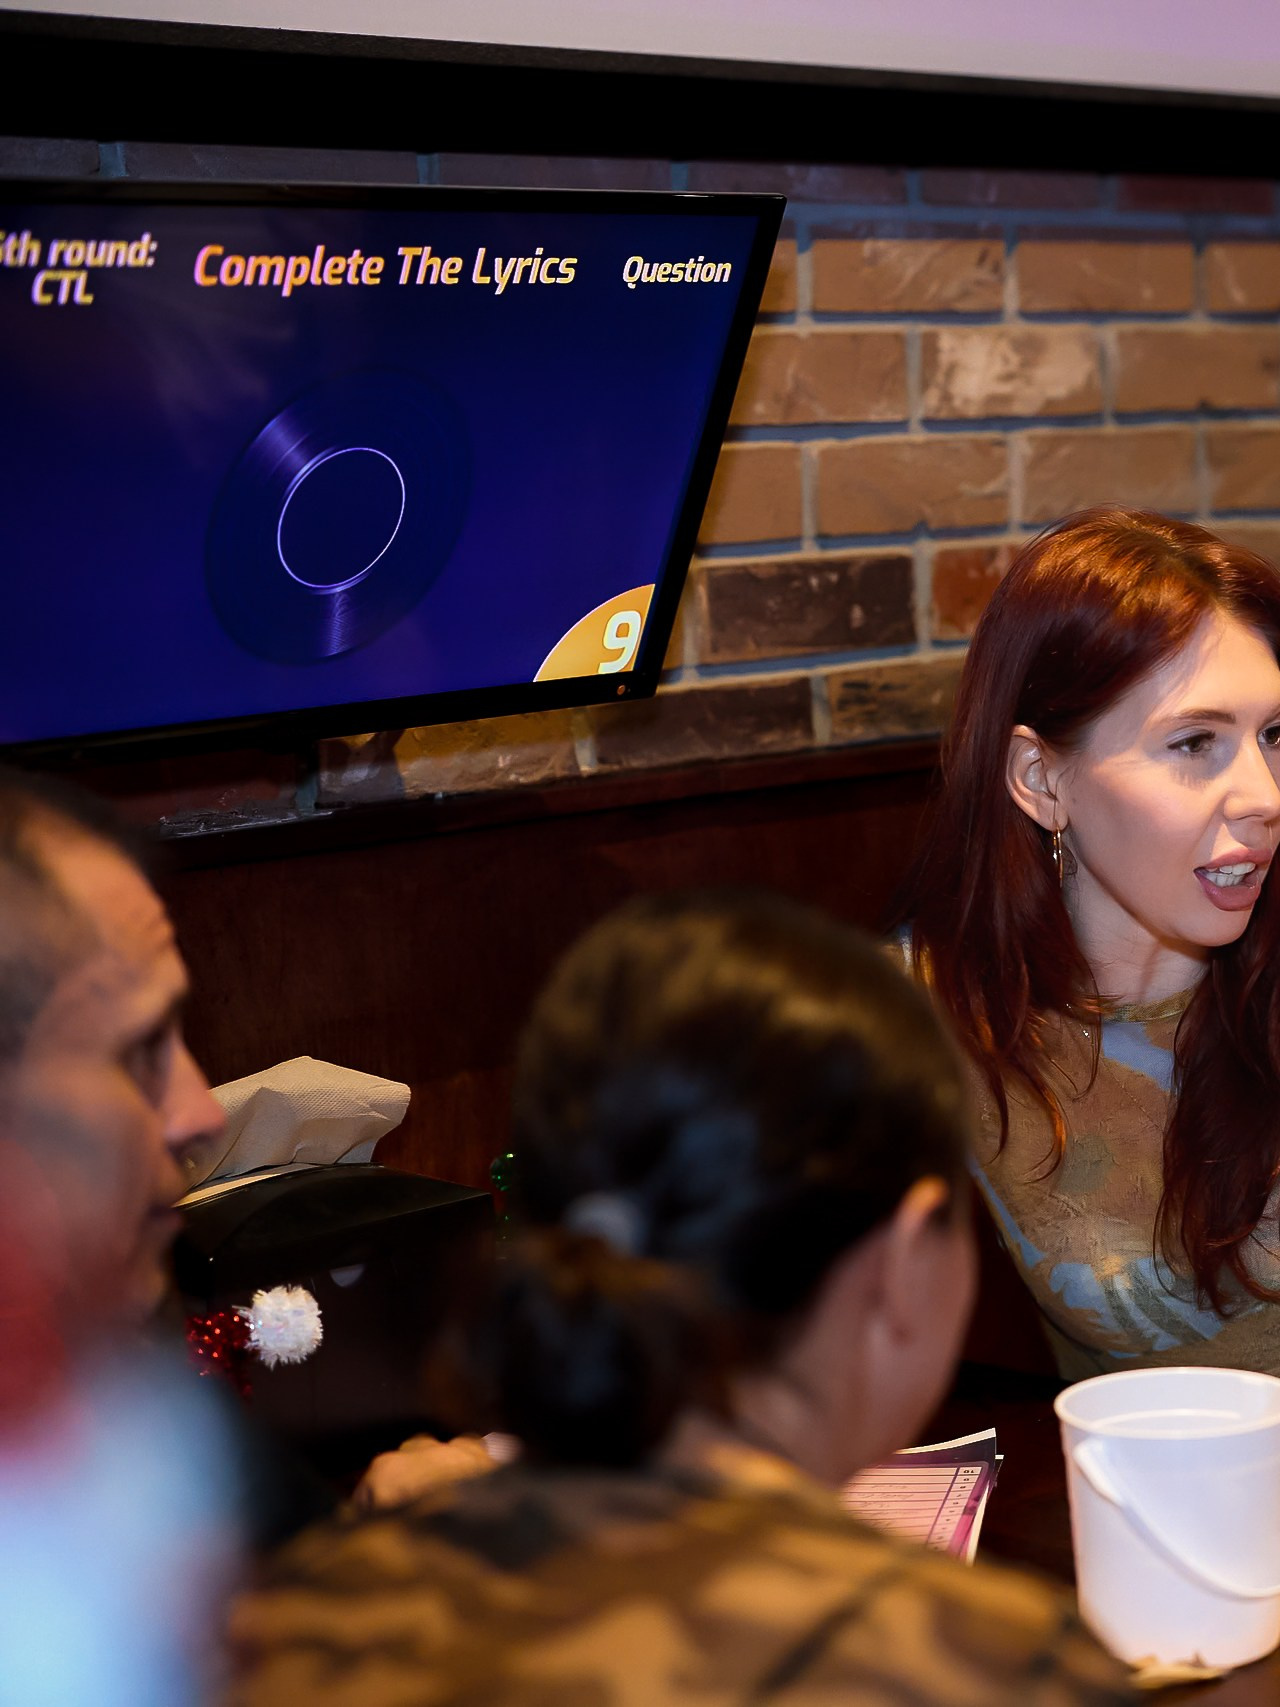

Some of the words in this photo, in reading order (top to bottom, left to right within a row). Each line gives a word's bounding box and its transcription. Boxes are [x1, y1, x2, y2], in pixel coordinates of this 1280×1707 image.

[47, 231, 158, 268] round:
[31, 269, 94, 305] CTL
[194, 245, 385, 297] Complete
[398, 246, 463, 285] The
[472, 247, 578, 295] Lyrics
[622, 255, 732, 289] Question
[598, 610, 642, 674] 9
